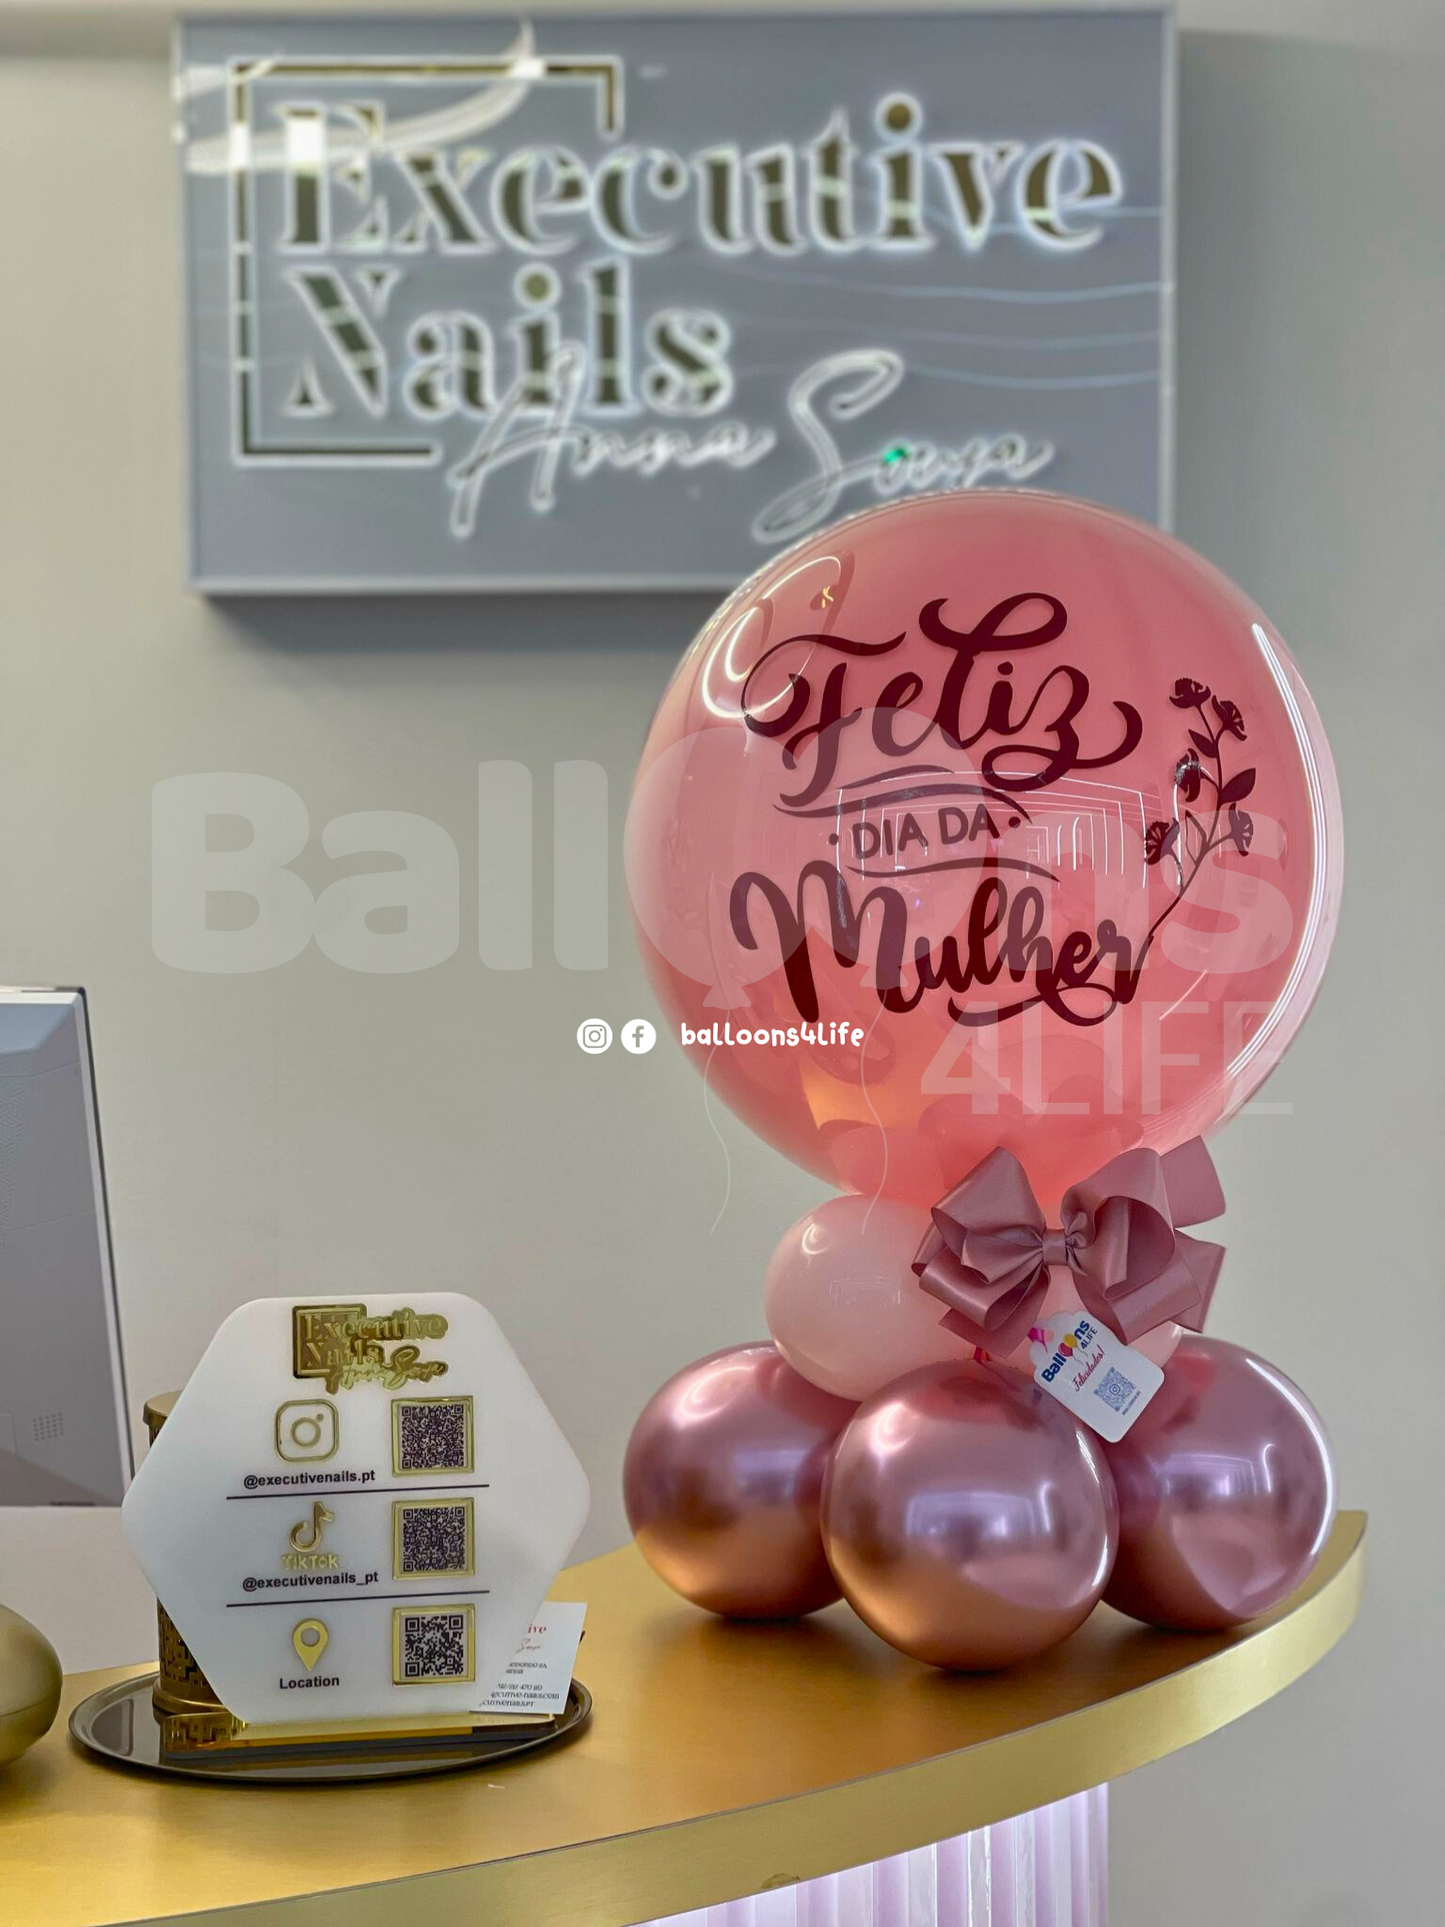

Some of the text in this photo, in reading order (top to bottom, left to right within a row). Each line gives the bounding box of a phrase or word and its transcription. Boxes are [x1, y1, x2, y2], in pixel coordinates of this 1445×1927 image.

[275, 92, 1122, 256] Executive
[282, 256, 735, 420] Nails
[742, 592, 1142, 806] Feliz
[853, 803, 1000, 859] DIA DA
[729, 860, 1154, 1026] Mulher
[303, 1312, 443, 1340] Executive
[1080, 1328, 1098, 1351] 4LIFE
[243, 1470, 376, 1490] @executivenails.pt
[242, 1571, 379, 1592] @executivenails_pt
[279, 1675, 340, 1690] Location
